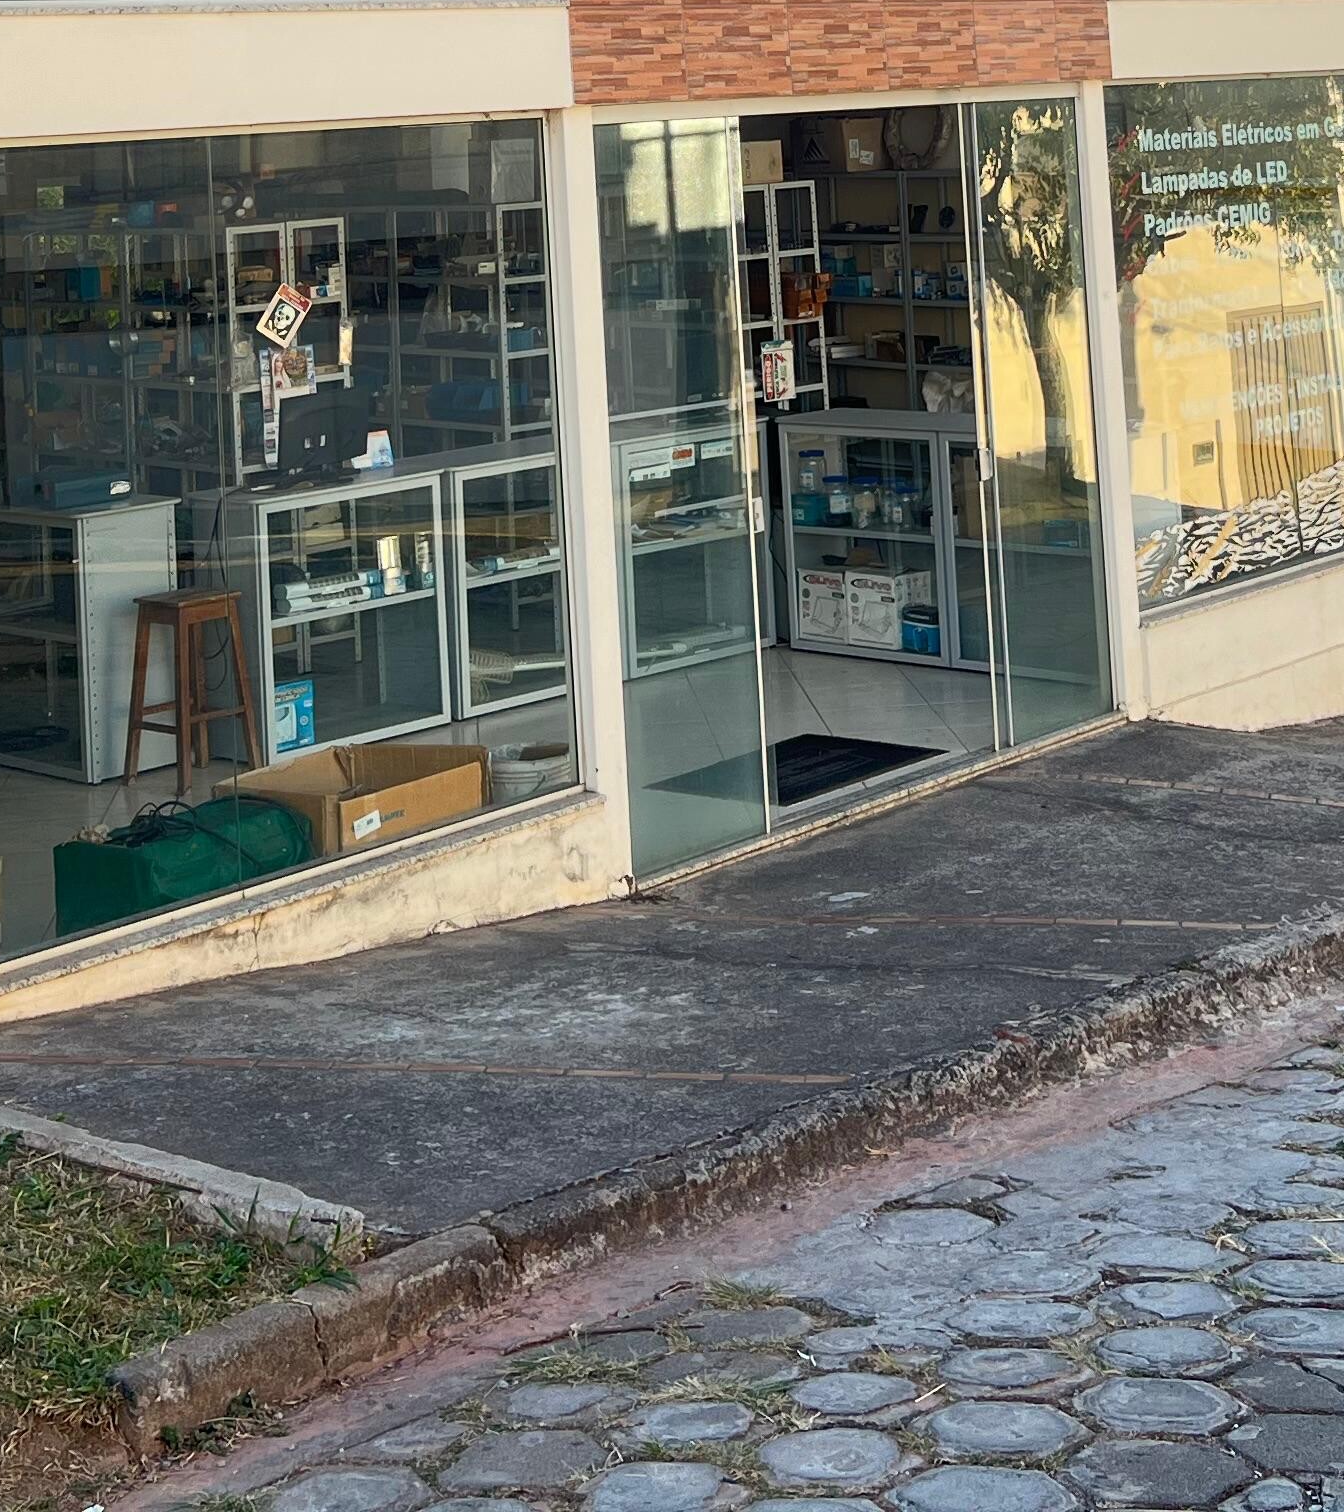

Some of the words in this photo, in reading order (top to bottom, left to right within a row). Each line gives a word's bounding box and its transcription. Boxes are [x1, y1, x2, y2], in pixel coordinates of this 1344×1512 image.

[1138, 126, 1218, 153] Materiais
[1221, 121, 1293, 147] Elétricos
[1296, 122, 1320, 140] em
[1141, 167, 1228, 197] Lampadas
[1232, 163, 1253, 187] de
[1256, 160, 1288, 185] LED
[1217, 202, 1271, 229] CEMIG
[1255, 406, 1325, 438] PROJETOS
